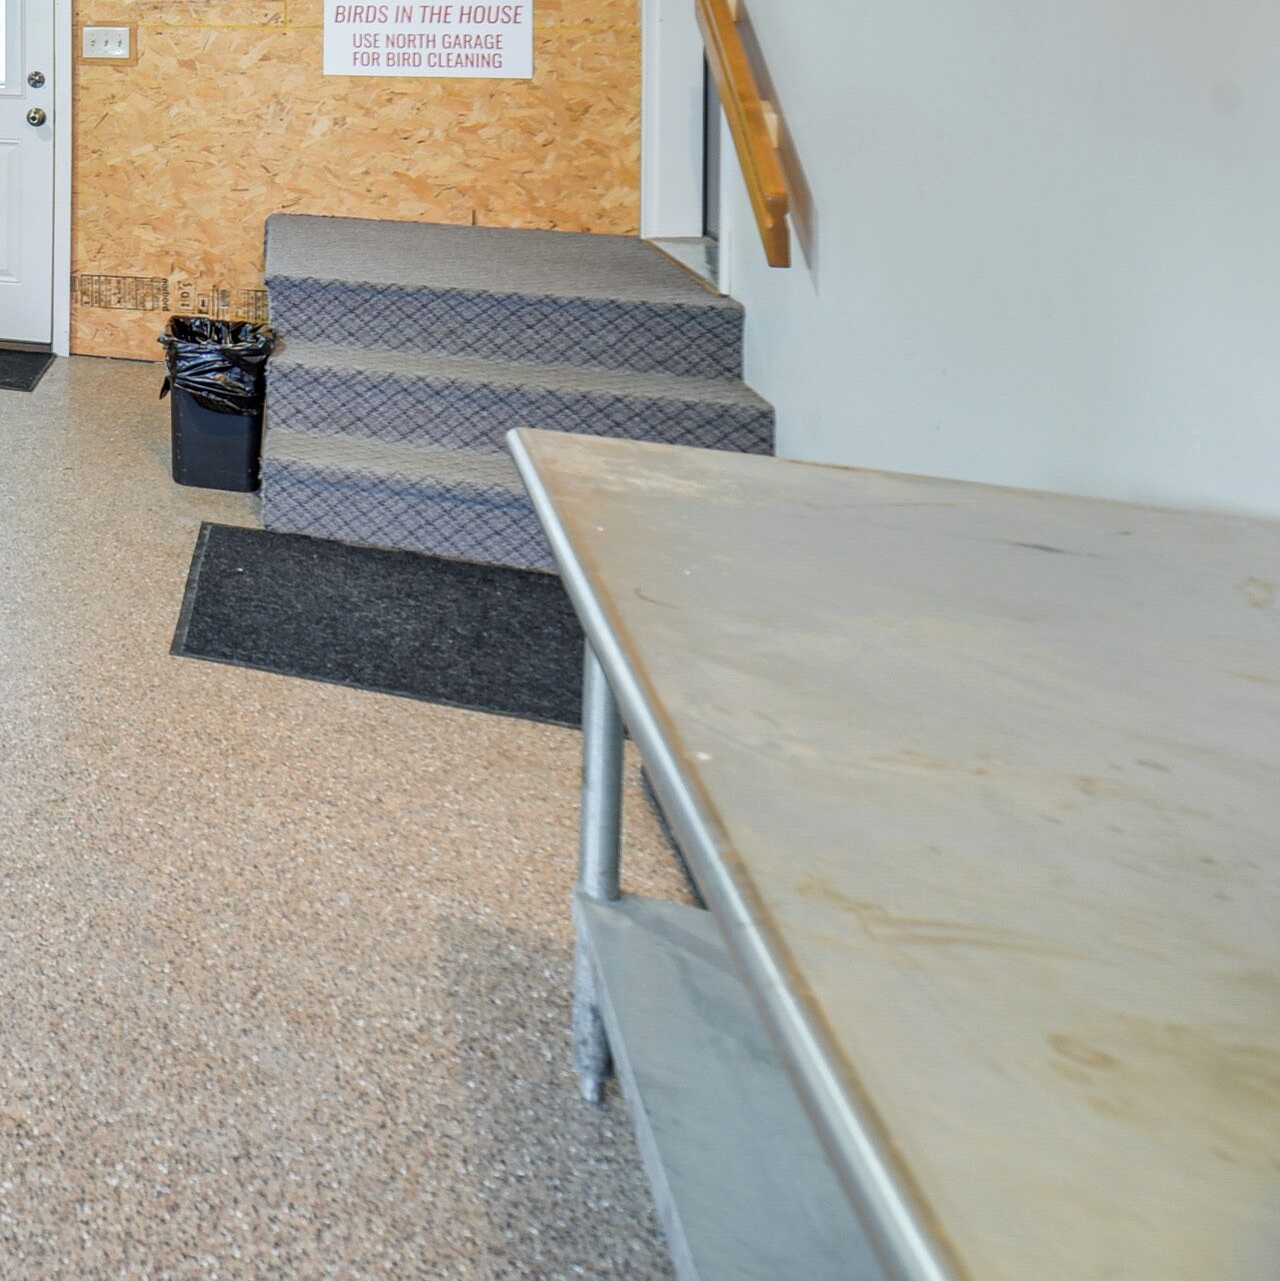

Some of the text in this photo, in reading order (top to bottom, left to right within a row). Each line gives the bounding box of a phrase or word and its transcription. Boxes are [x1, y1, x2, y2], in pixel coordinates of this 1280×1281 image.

[334, 4, 524, 24] BIRDS IN THE HOUSE
[352, 34, 503, 50] USE NORTH GARAGE
[352, 52, 502, 69] FOR BIRD CLEANING
